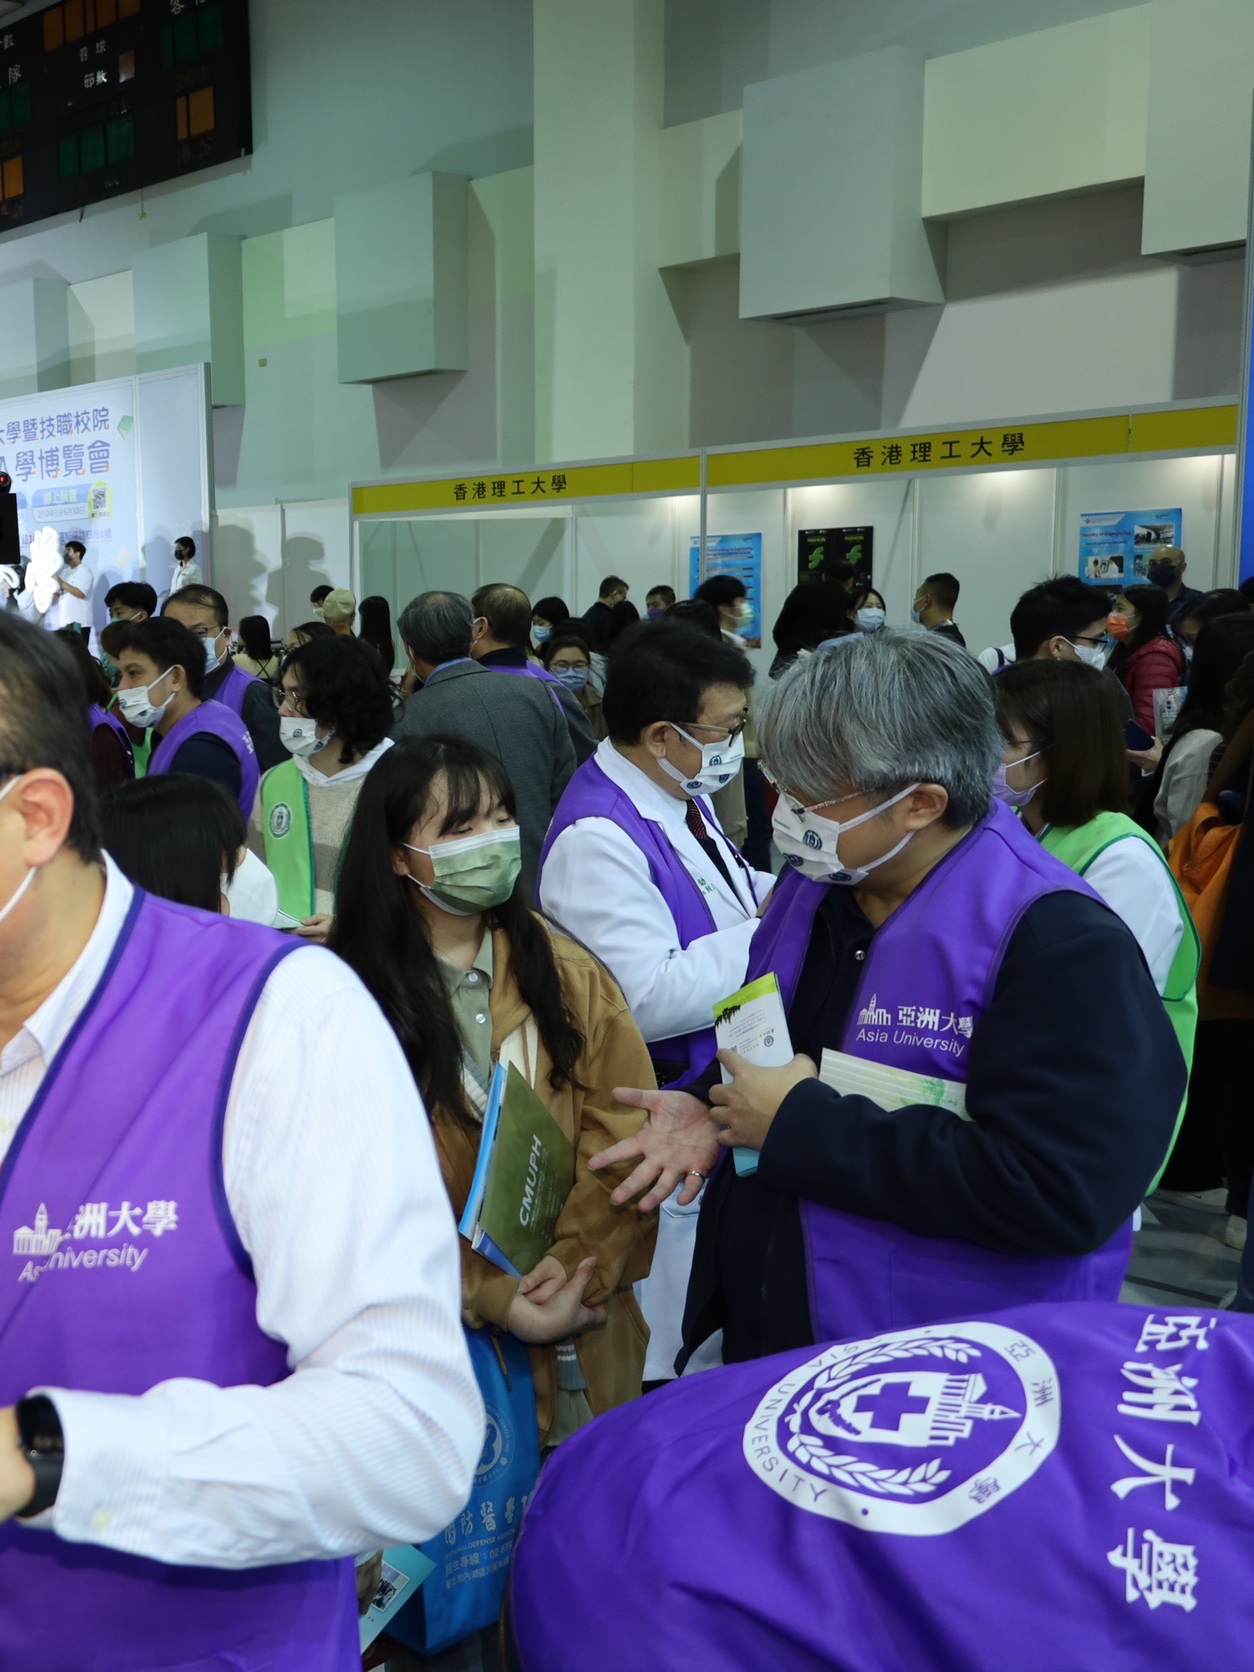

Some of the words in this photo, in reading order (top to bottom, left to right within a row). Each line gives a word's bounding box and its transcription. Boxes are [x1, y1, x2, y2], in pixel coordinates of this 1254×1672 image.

[853, 432, 1025, 468] 香港理工大學
[454, 474, 567, 501] 香港理工大學
[896, 1005, 973, 1038] 亞洲大學
[856, 1028, 888, 1042] Asia
[893, 1030, 964, 1057] University
[519, 1134, 542, 1227] CMUPH
[72, 1200, 179, 1240] 洲大學
[48, 1243, 149, 1272] niversity
[752, 1382, 828, 1503] UNIVERSITY
[1107, 1314, 1217, 1613] 亞洲大學
